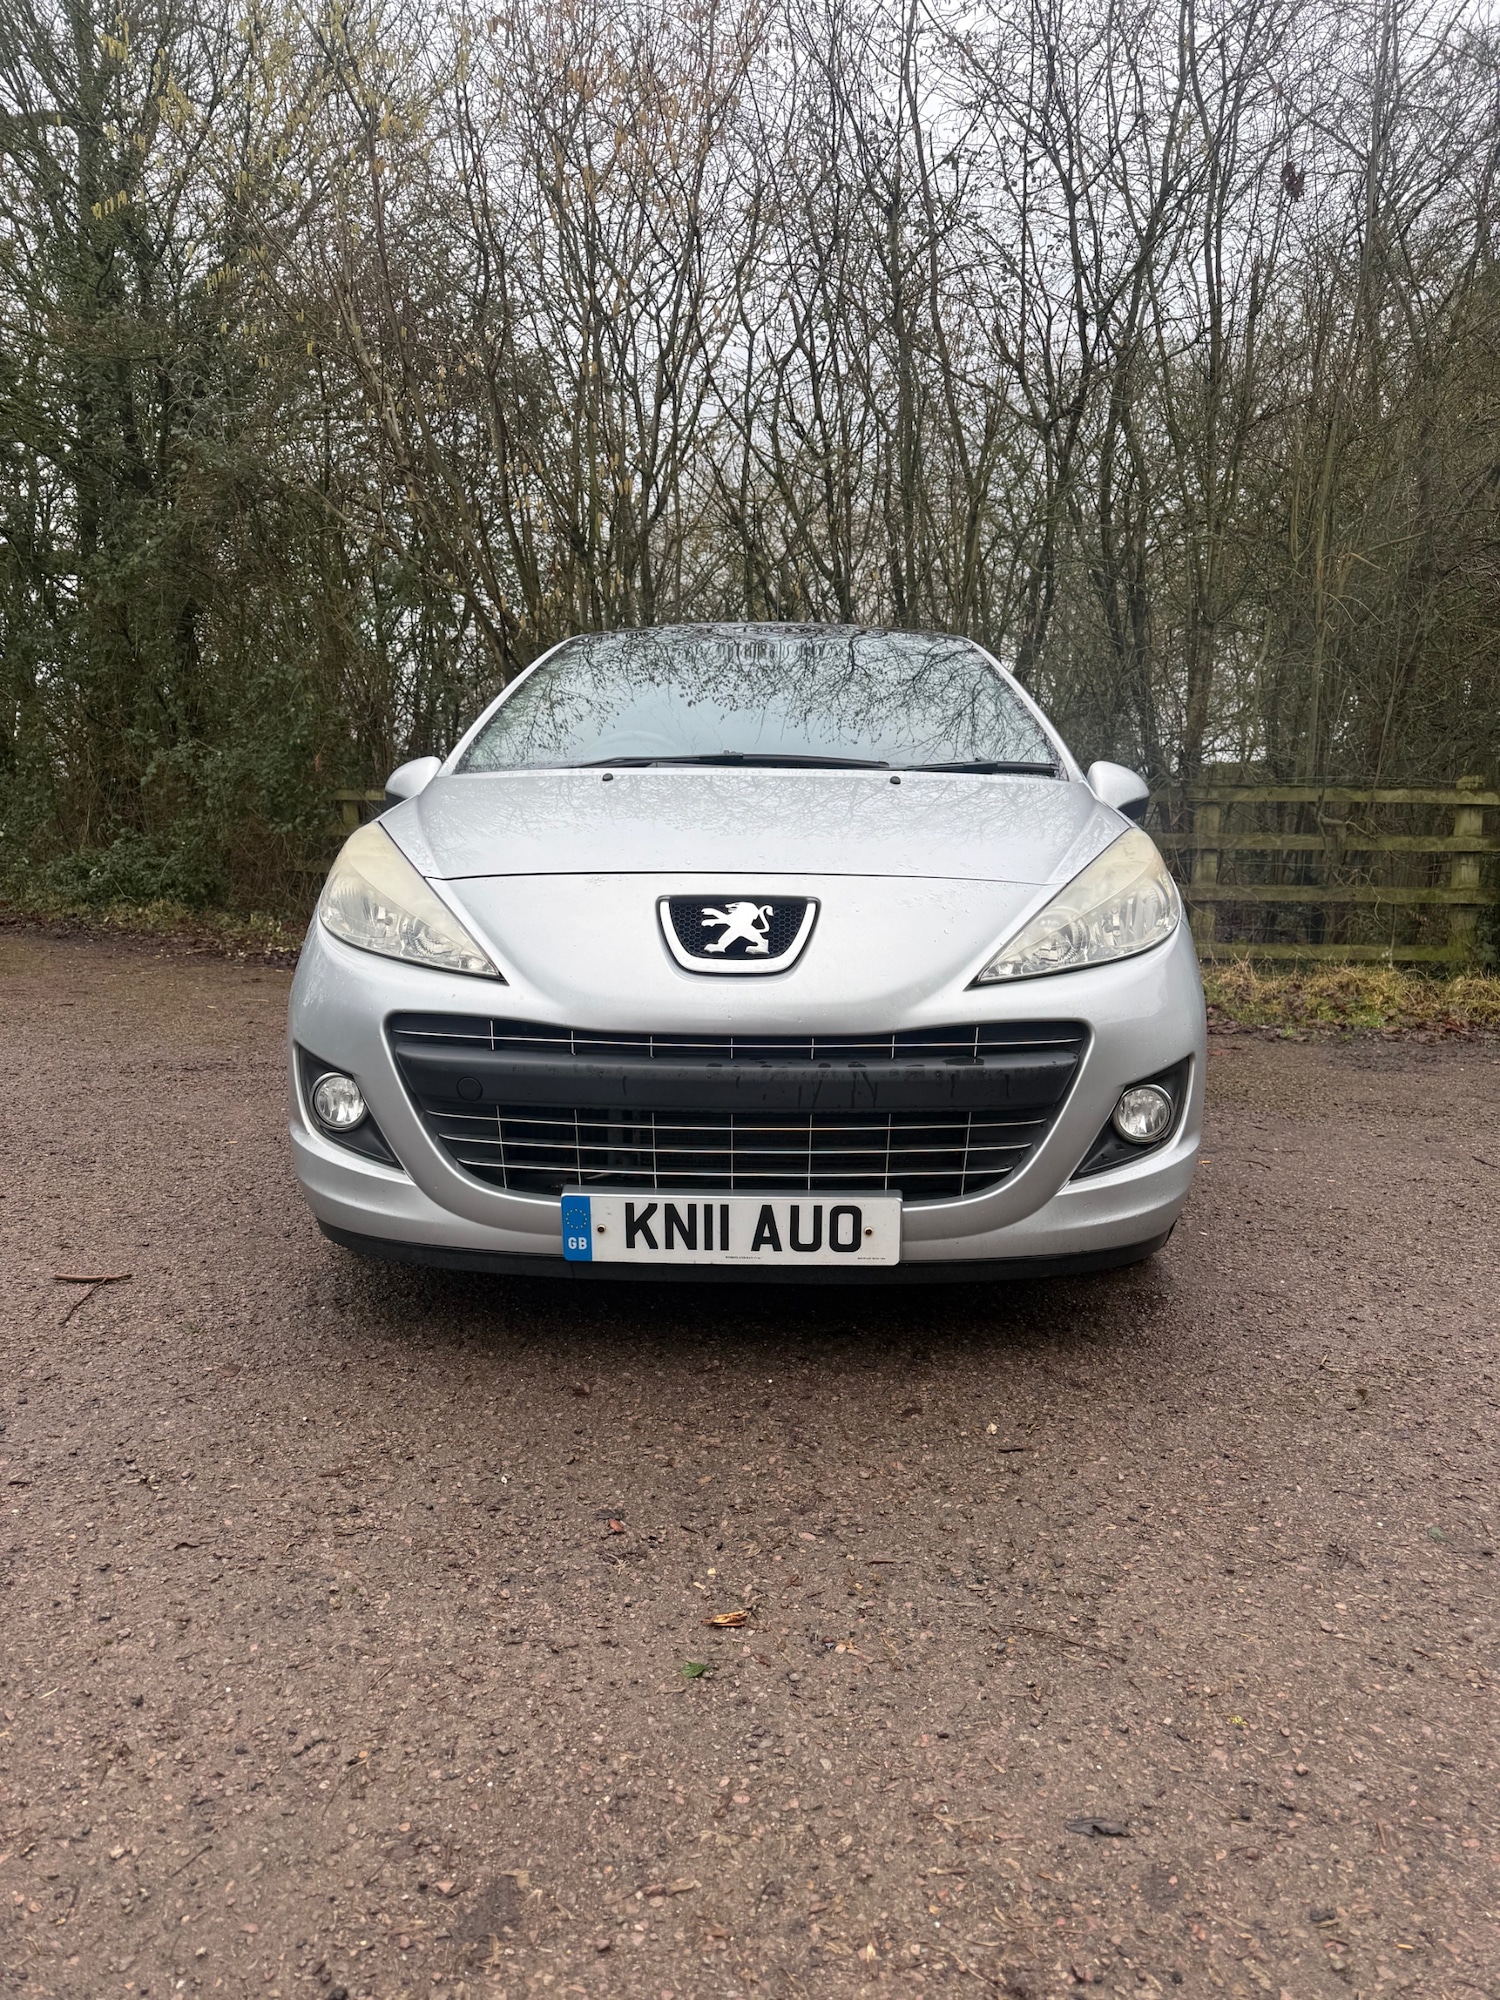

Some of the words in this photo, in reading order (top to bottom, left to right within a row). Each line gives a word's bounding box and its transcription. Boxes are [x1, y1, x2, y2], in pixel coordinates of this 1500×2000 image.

[568, 1236, 588, 1250] GB
[624, 1202, 730, 1251] KN11
[750, 1204, 863, 1253] AUO
